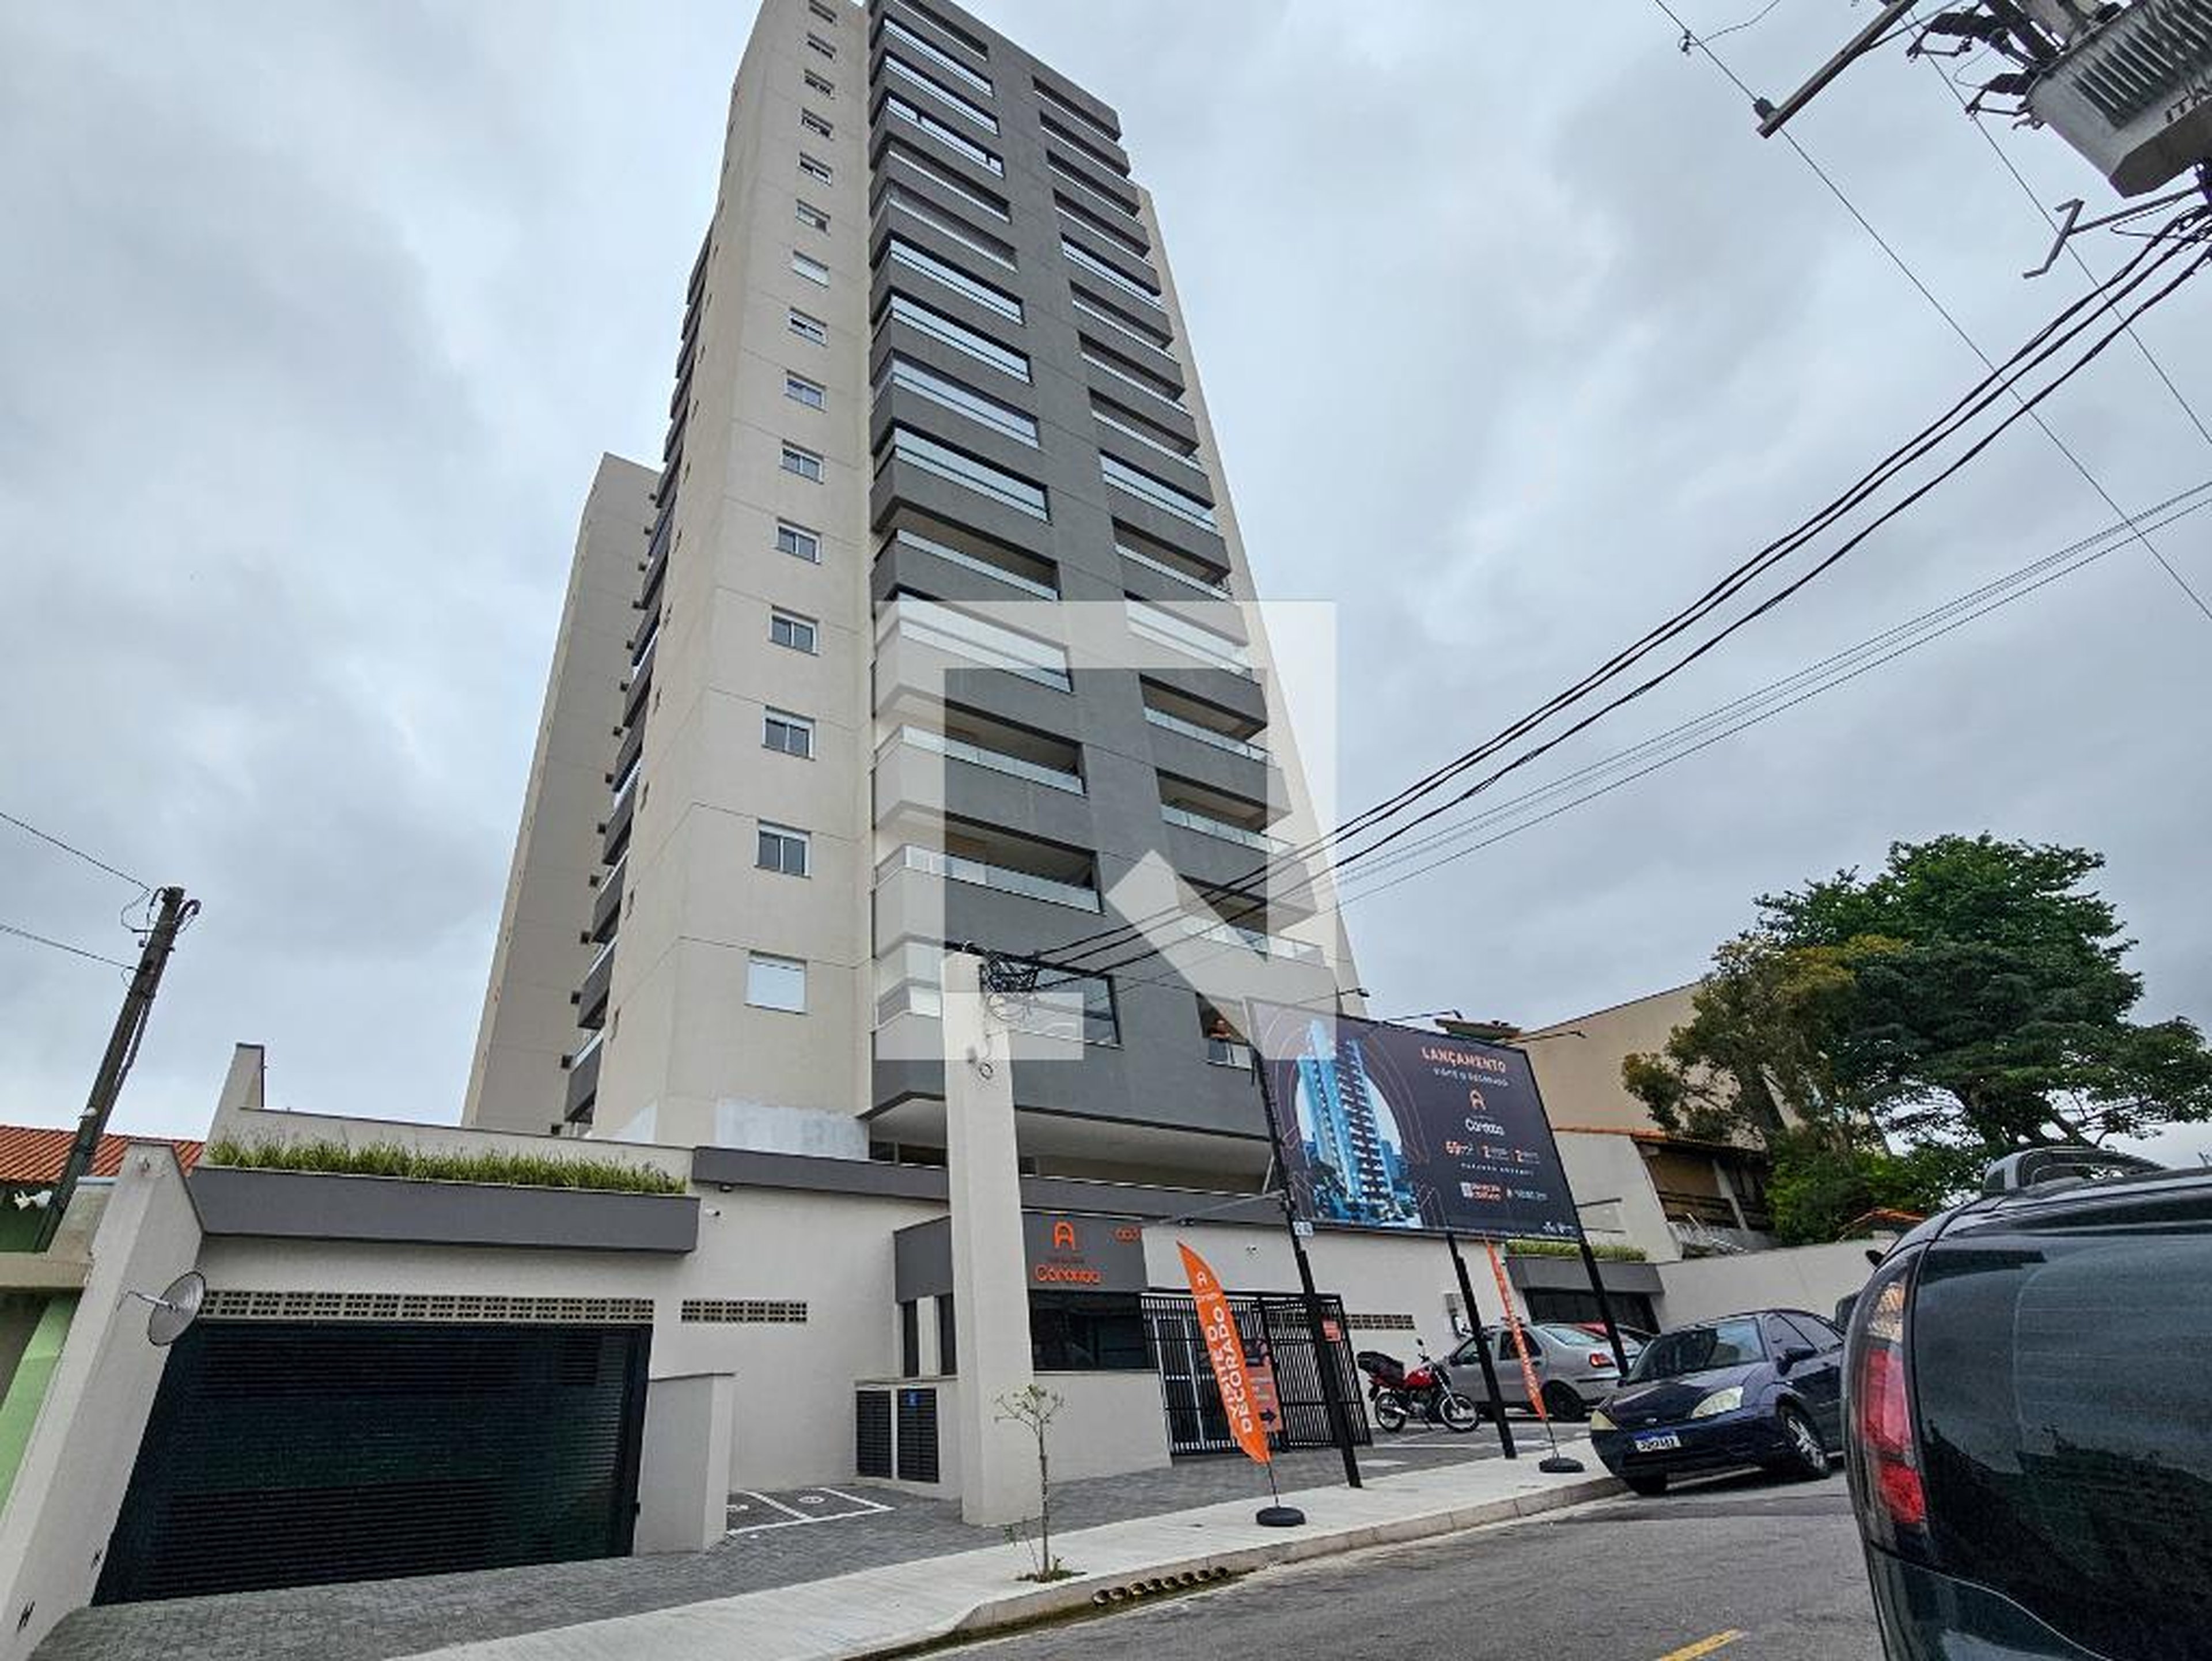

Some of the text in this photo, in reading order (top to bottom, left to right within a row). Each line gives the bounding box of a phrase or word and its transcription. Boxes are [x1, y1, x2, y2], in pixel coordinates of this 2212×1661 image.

[1422, 1047, 1506, 1073] LANÇAMENTO
[1208, 1326, 1239, 1420] VISITE O
[1213, 1306, 1253, 1433] DECORADO
